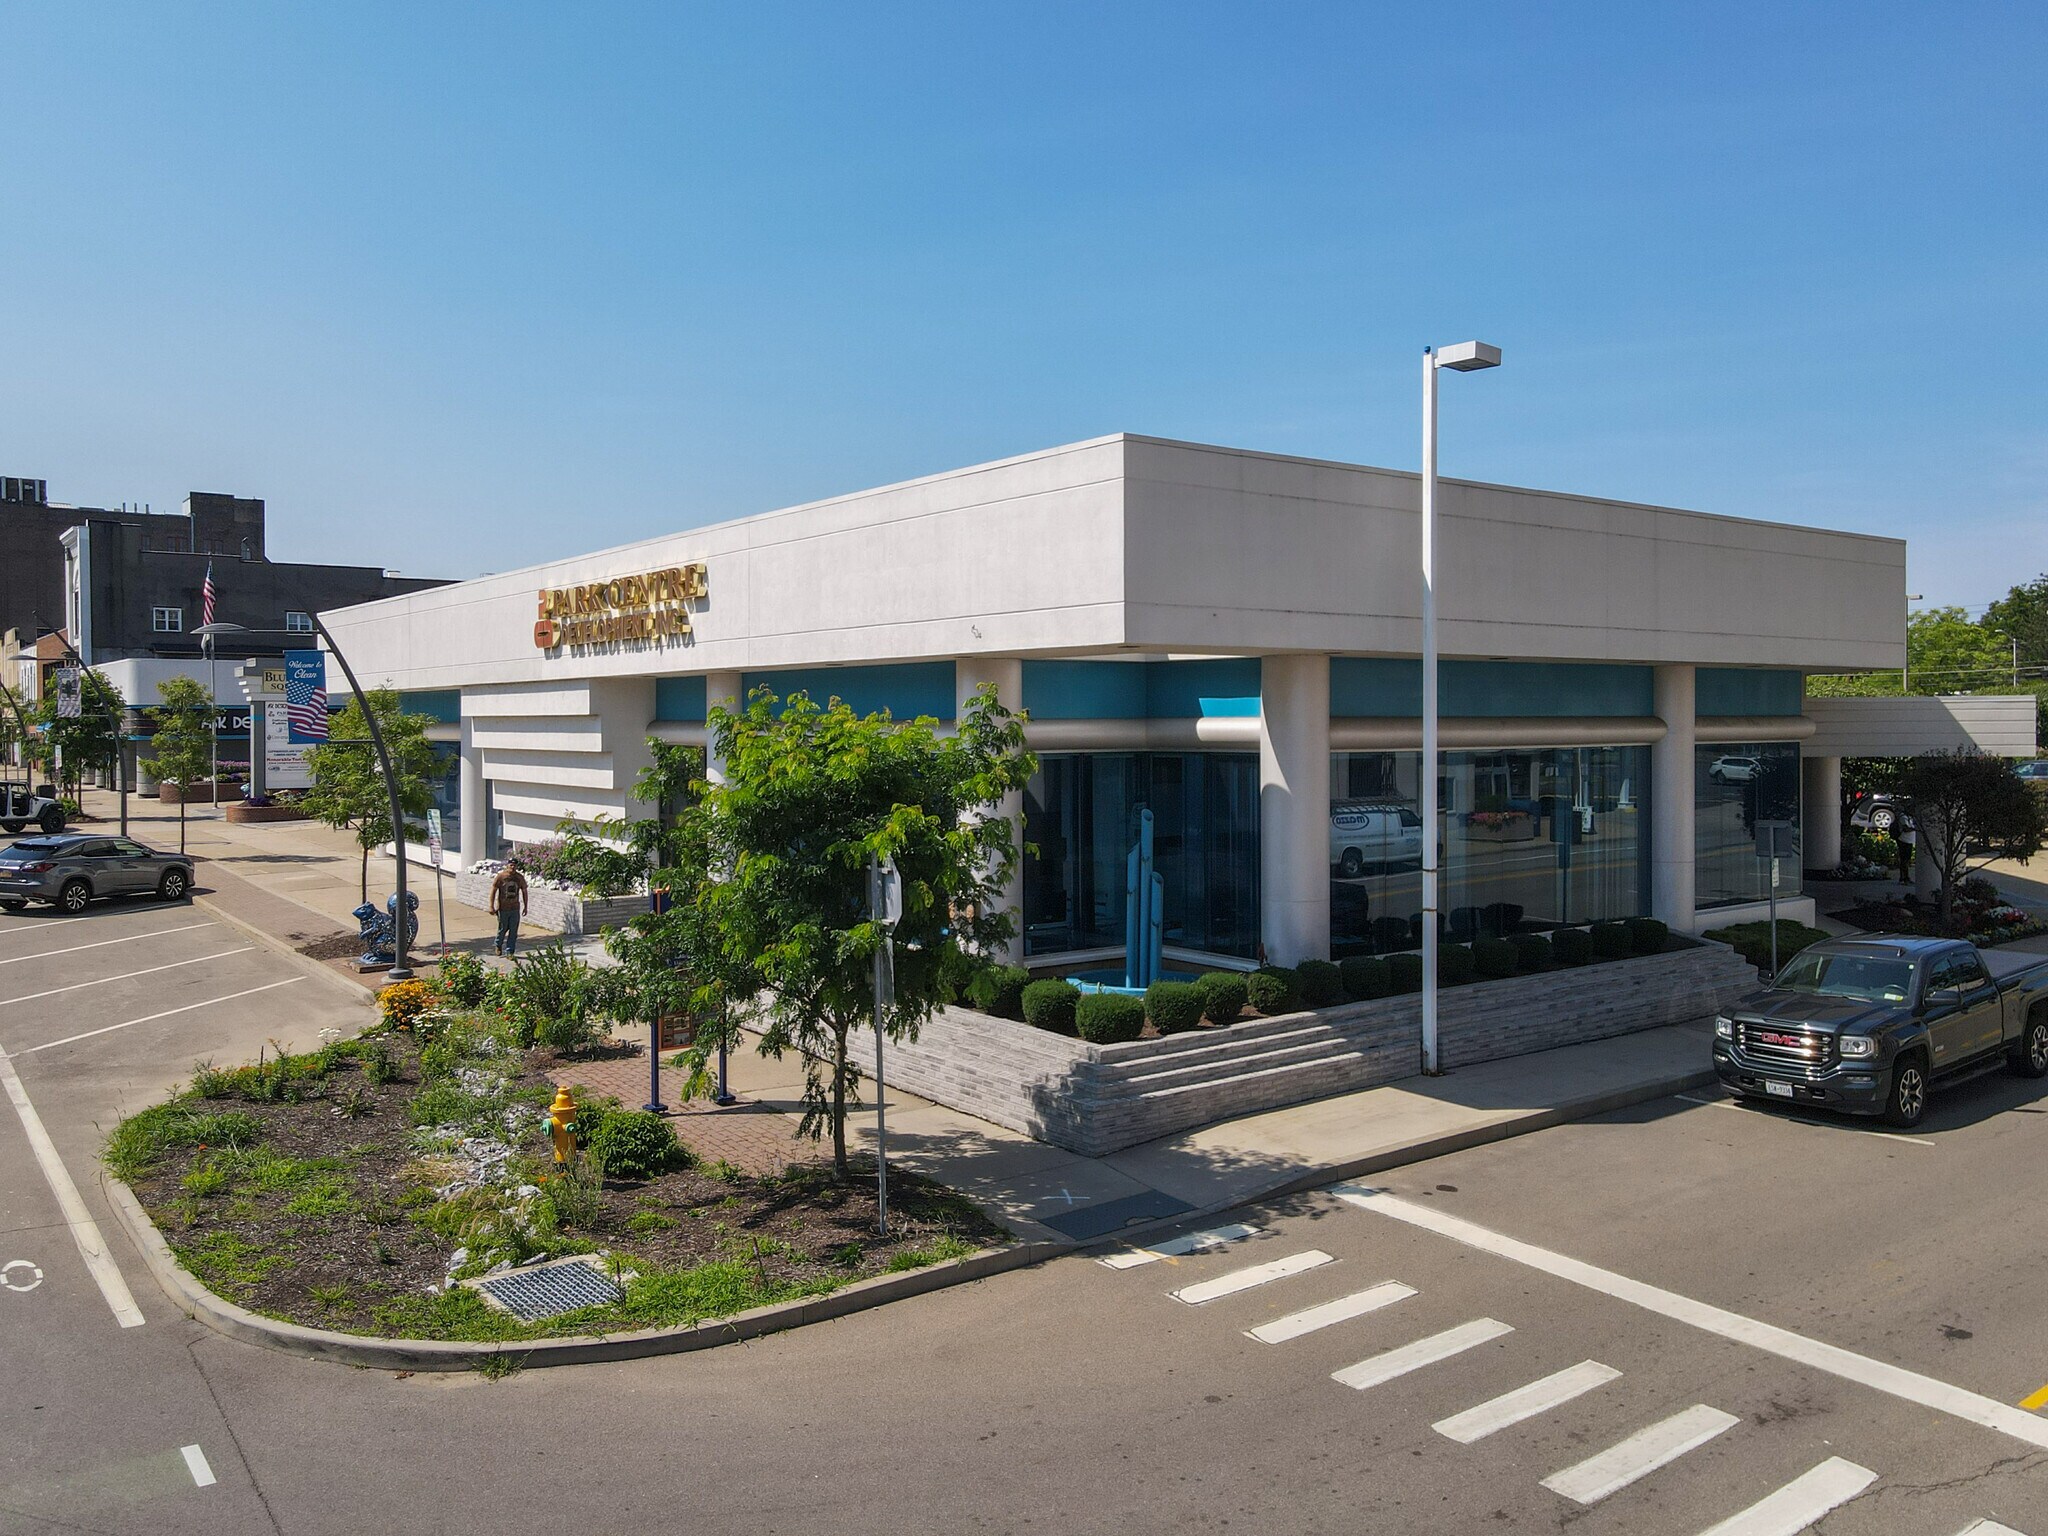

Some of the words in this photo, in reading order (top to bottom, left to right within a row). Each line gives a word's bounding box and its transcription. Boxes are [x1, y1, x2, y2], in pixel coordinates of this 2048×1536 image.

[552, 583, 604, 616] PARK
[607, 563, 706, 609] CENTRE
[288, 660, 314, 669] Welcome
[315, 660, 322, 668] to
[1762, 1032, 1800, 1046] GMC
